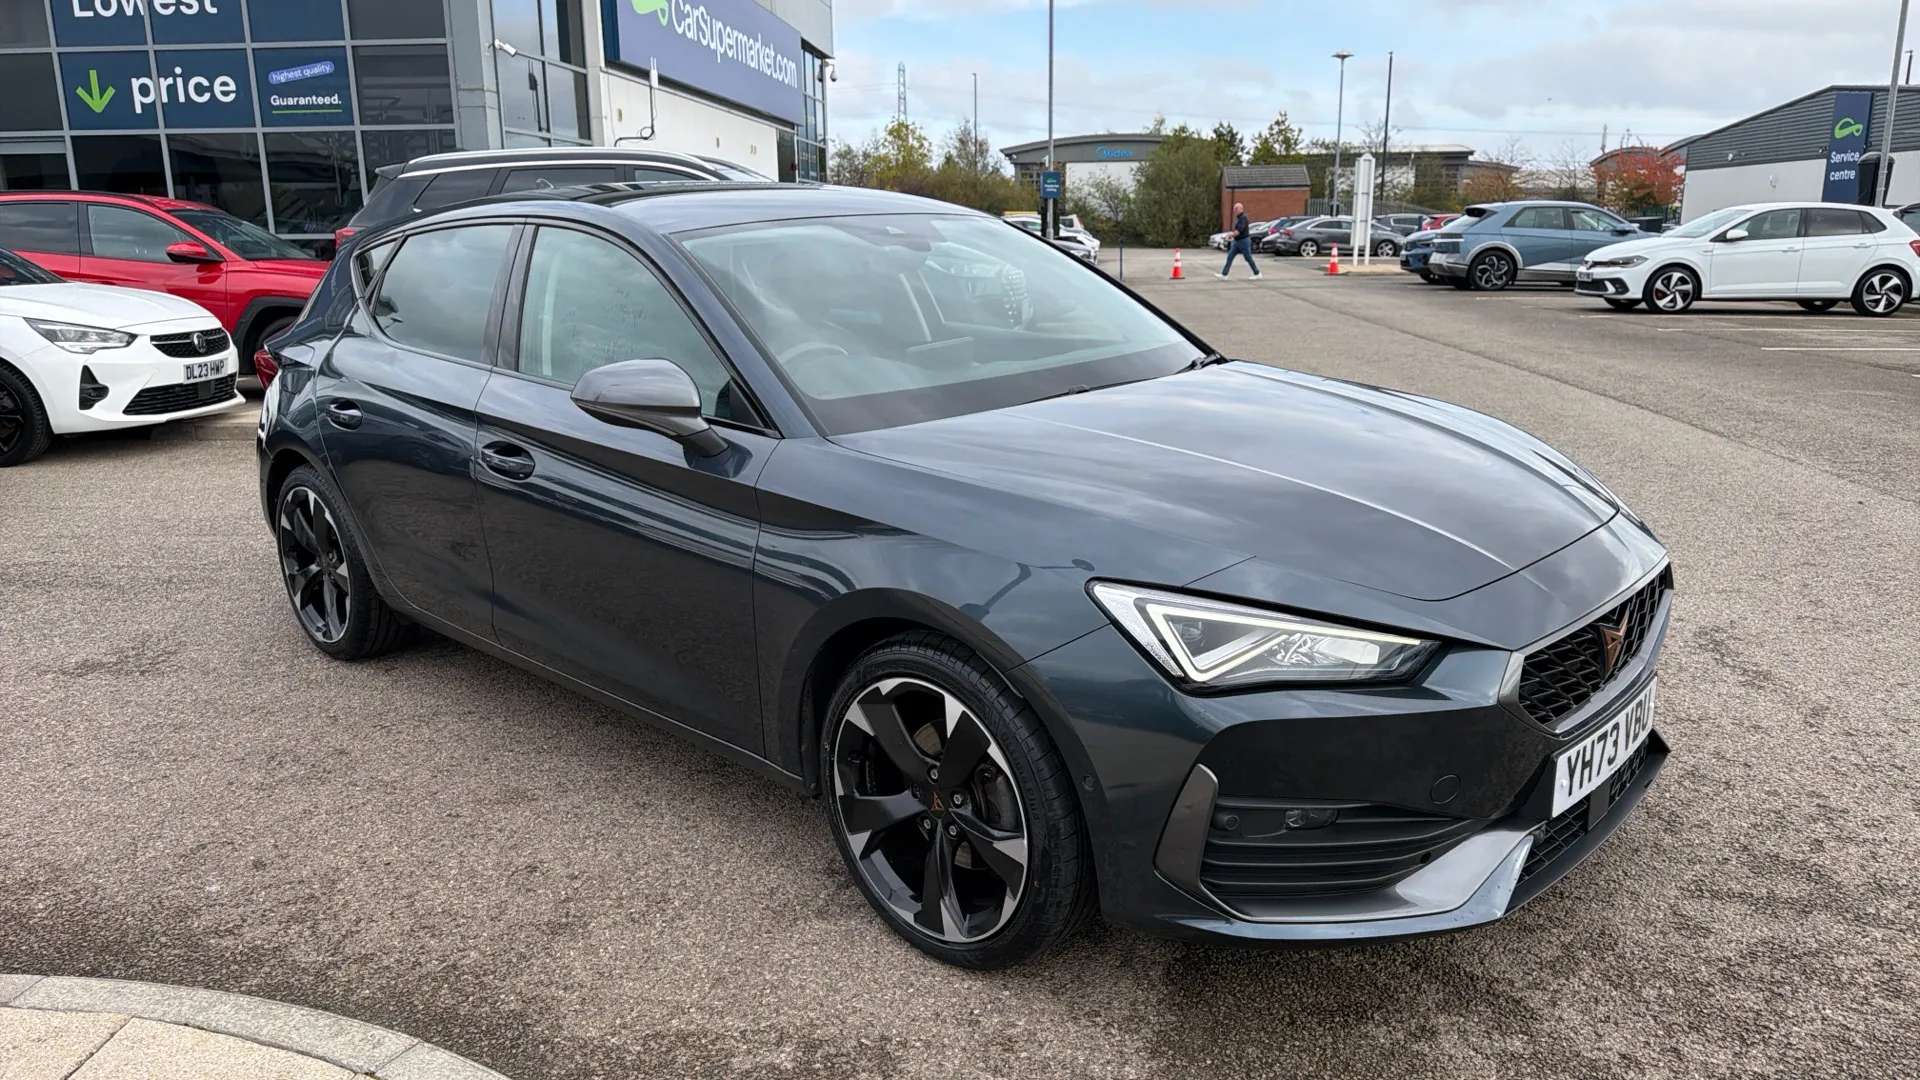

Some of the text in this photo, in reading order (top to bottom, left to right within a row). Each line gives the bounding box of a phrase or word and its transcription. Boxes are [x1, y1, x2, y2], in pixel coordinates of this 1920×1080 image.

[671, 0, 798, 89] CarSupermarket.com
[271, 62, 331, 83] highest quality
[130, 66, 237, 114] price
[270, 93, 342, 106] Guaranteed.
[1830, 149, 1860, 163] Service
[1829, 169, 1856, 181] centre
[186, 360, 225, 380] DL23 HWP
[1567, 687, 1652, 797] YH73 VBU
